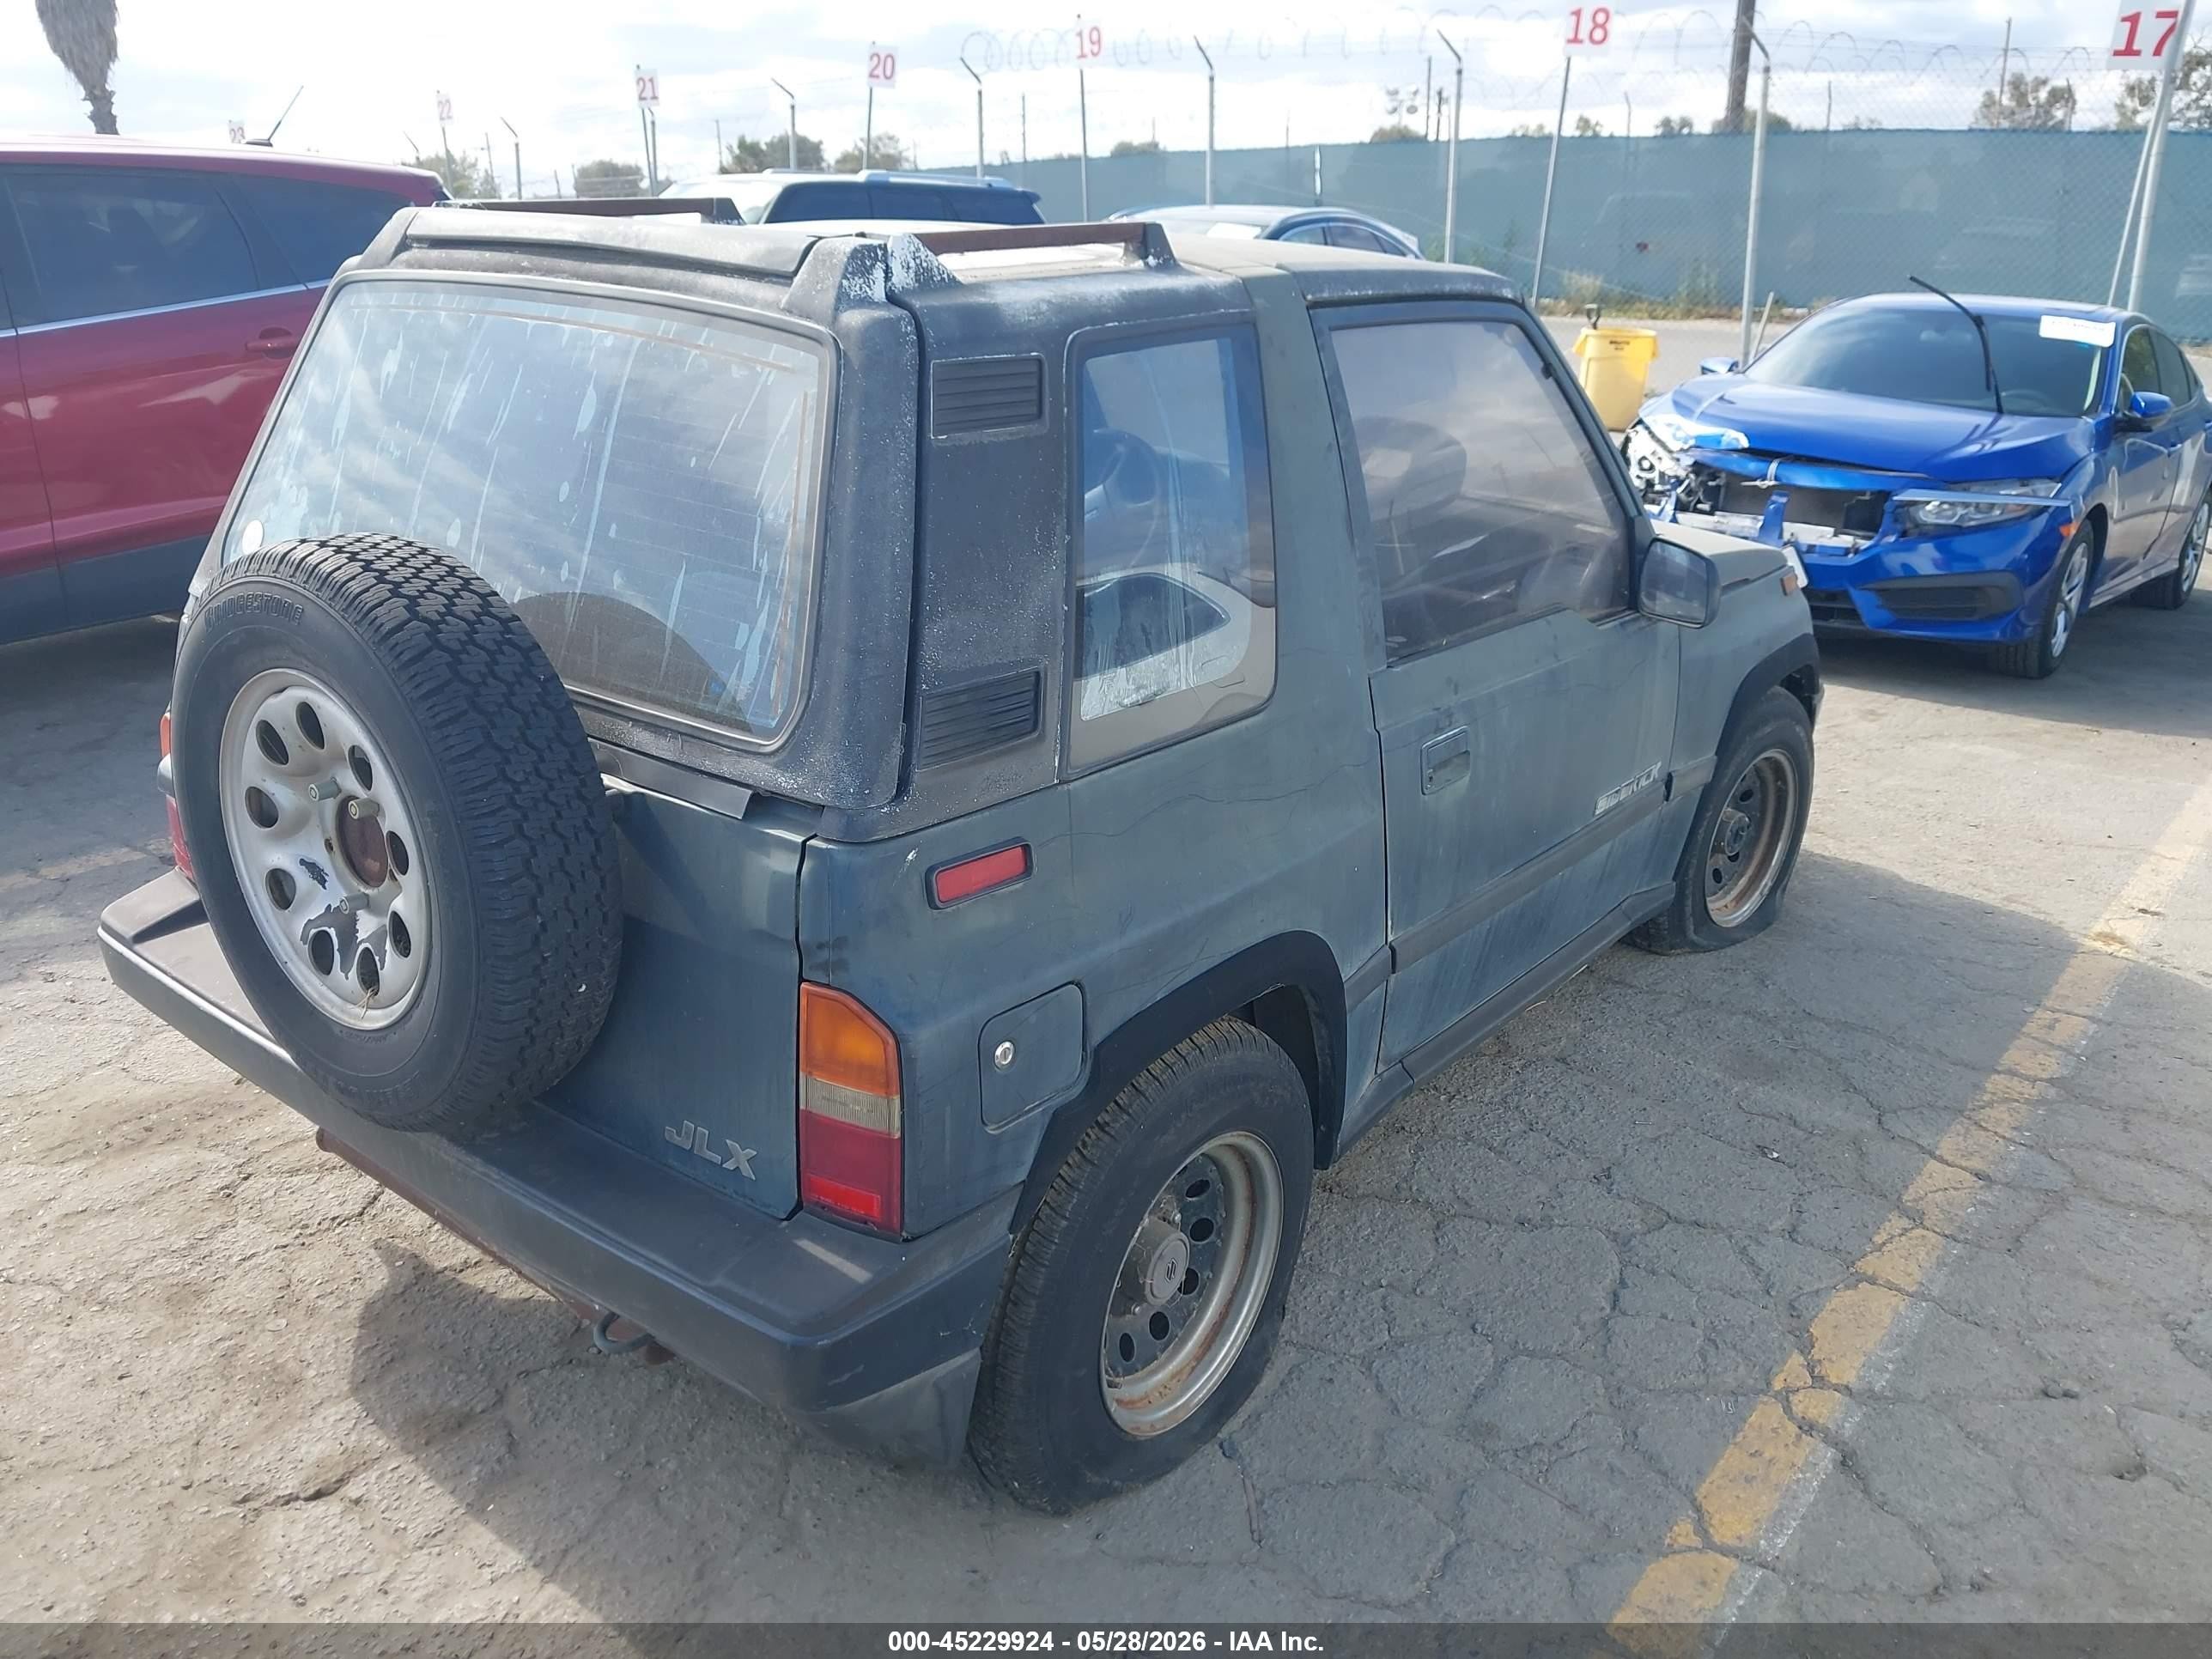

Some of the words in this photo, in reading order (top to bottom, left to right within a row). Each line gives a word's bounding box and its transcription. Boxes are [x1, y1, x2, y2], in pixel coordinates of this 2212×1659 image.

[1076, 27, 1101, 59] 19
[1567, 7, 1610, 46] 18
[2112, 10, 2179, 57] 17
[869, 52, 895, 80] 20
[636, 77, 659, 100] 21
[438, 99, 453, 120] 22
[204, 591, 304, 633] BRIDGESTONE
[1595, 761, 1662, 816] SIDEKICK
[665, 1119, 757, 1181] JLX
